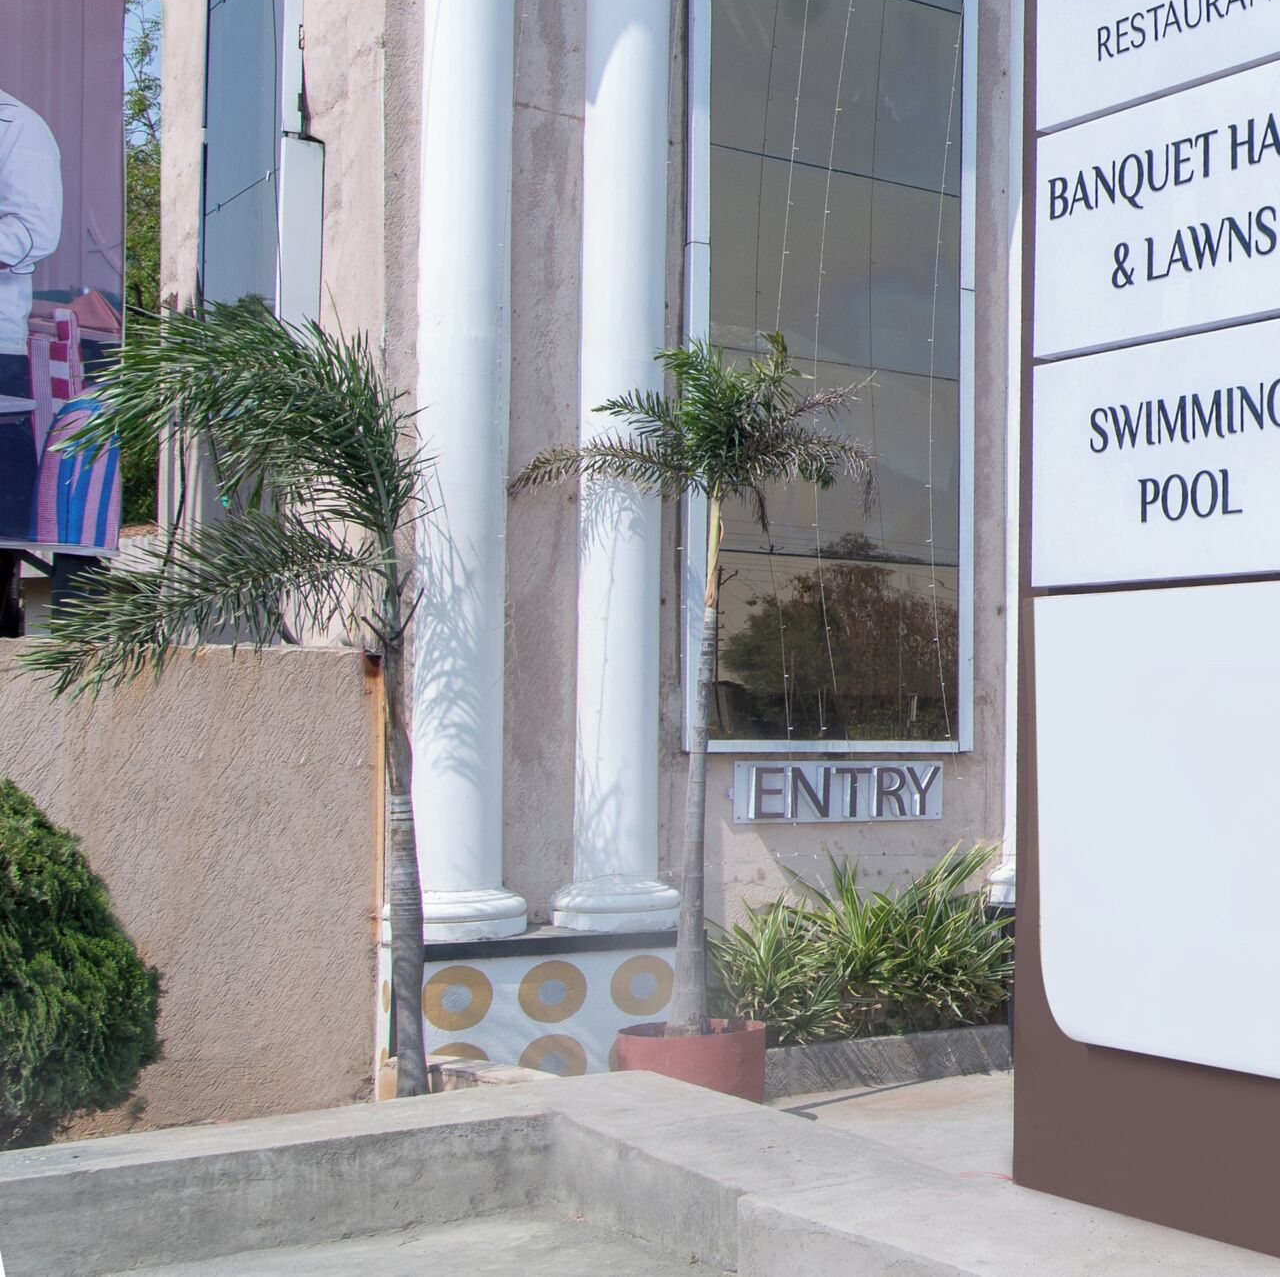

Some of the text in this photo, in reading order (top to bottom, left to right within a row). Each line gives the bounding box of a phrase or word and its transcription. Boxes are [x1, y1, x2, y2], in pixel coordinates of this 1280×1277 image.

[1048, 129, 1218, 220] BANQUET
[1111, 205, 1278, 288] & LAWNS
[1138, 469, 1243, 523] POOL
[748, 765, 941, 820] ENTRY
